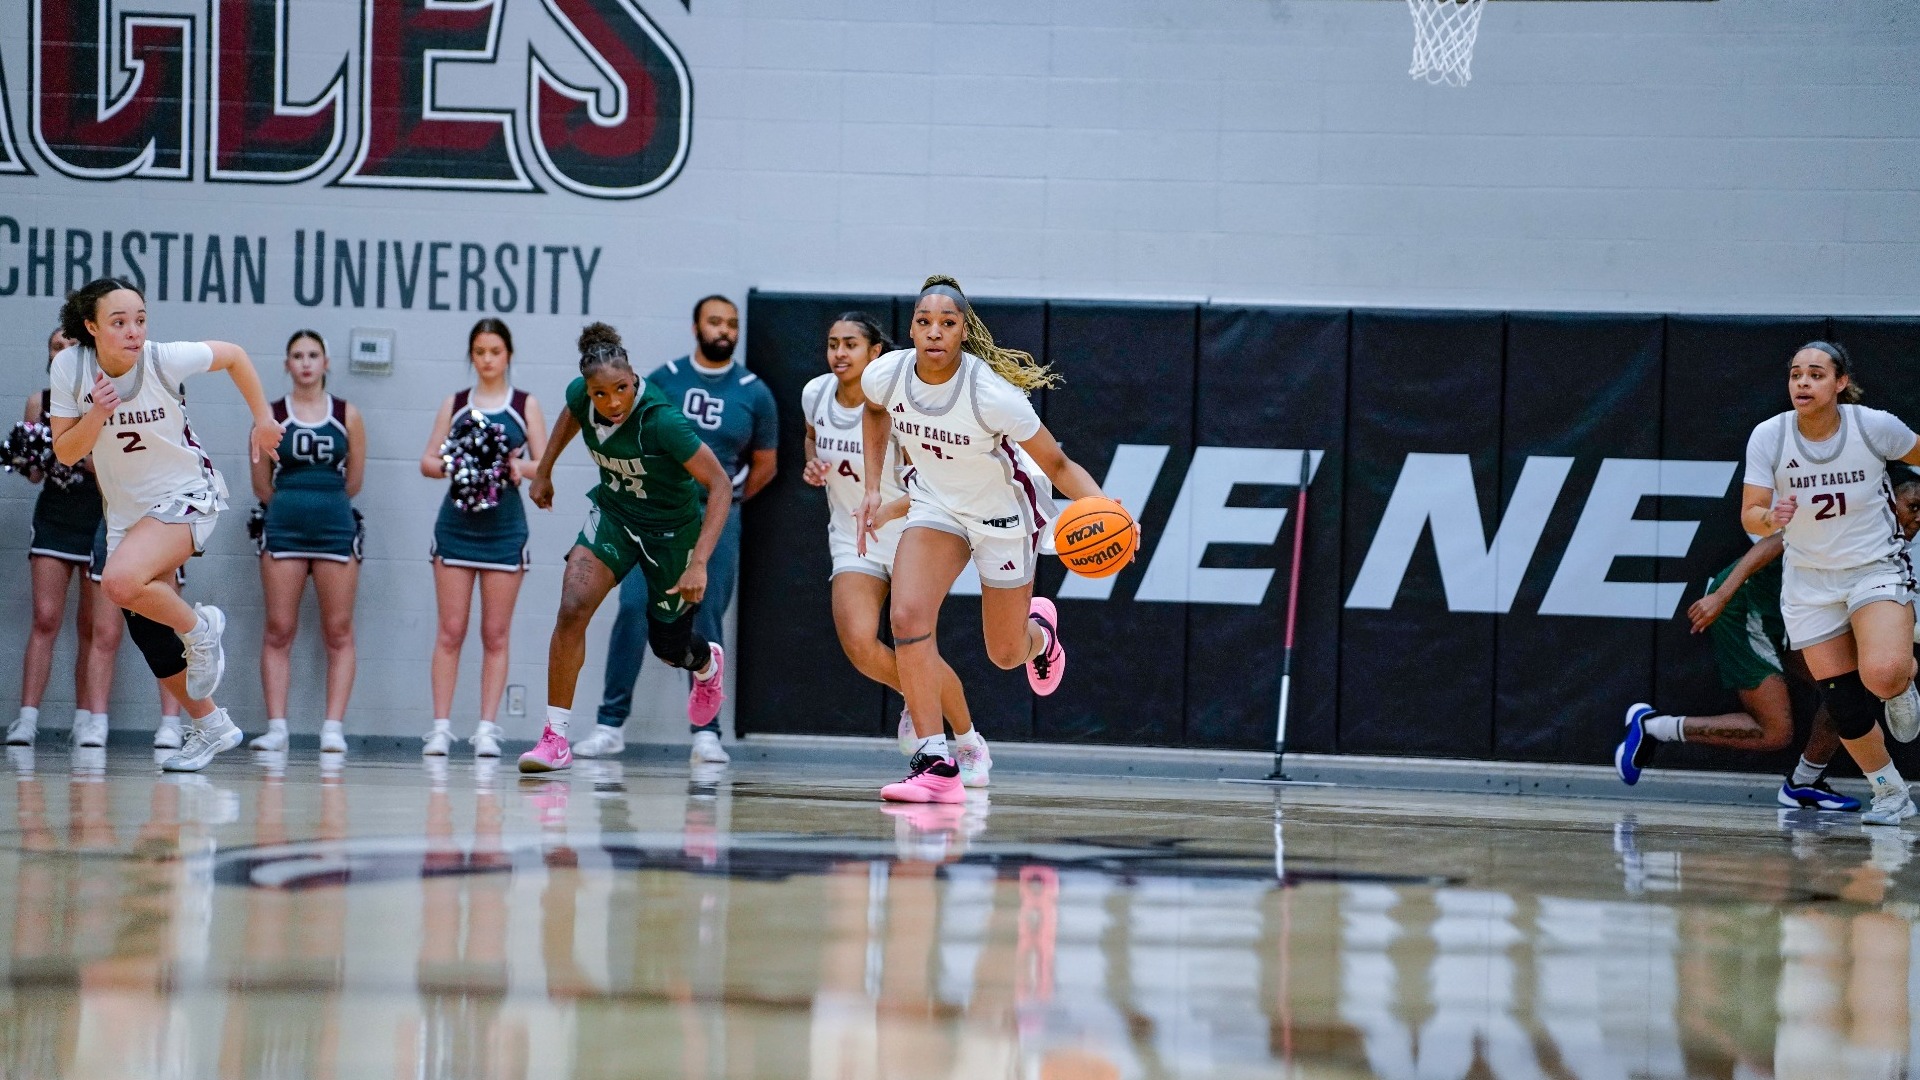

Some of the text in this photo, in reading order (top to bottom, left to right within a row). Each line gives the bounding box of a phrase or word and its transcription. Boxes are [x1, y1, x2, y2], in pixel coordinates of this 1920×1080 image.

[0, 0, 696, 200] GLES
[294, 229, 603, 315] UNIVERSITY
[119, 407, 166, 425] EAGLES
[683, 388, 725, 431] OC
[117, 432, 147, 453] 2
[893, 417, 970, 446] LADY EAGLES
[292, 428, 334, 464] OC
[837, 439, 863, 454] EAGL
[837, 459, 861, 483] 4
[1790, 470, 1866, 489] LADY EAGLES
[1811, 492, 1847, 521] 21
[949, 443, 1764, 620] HE NE
[1065, 521, 1105, 545] NCAA
[1071, 541, 1123, 566] Wilson
